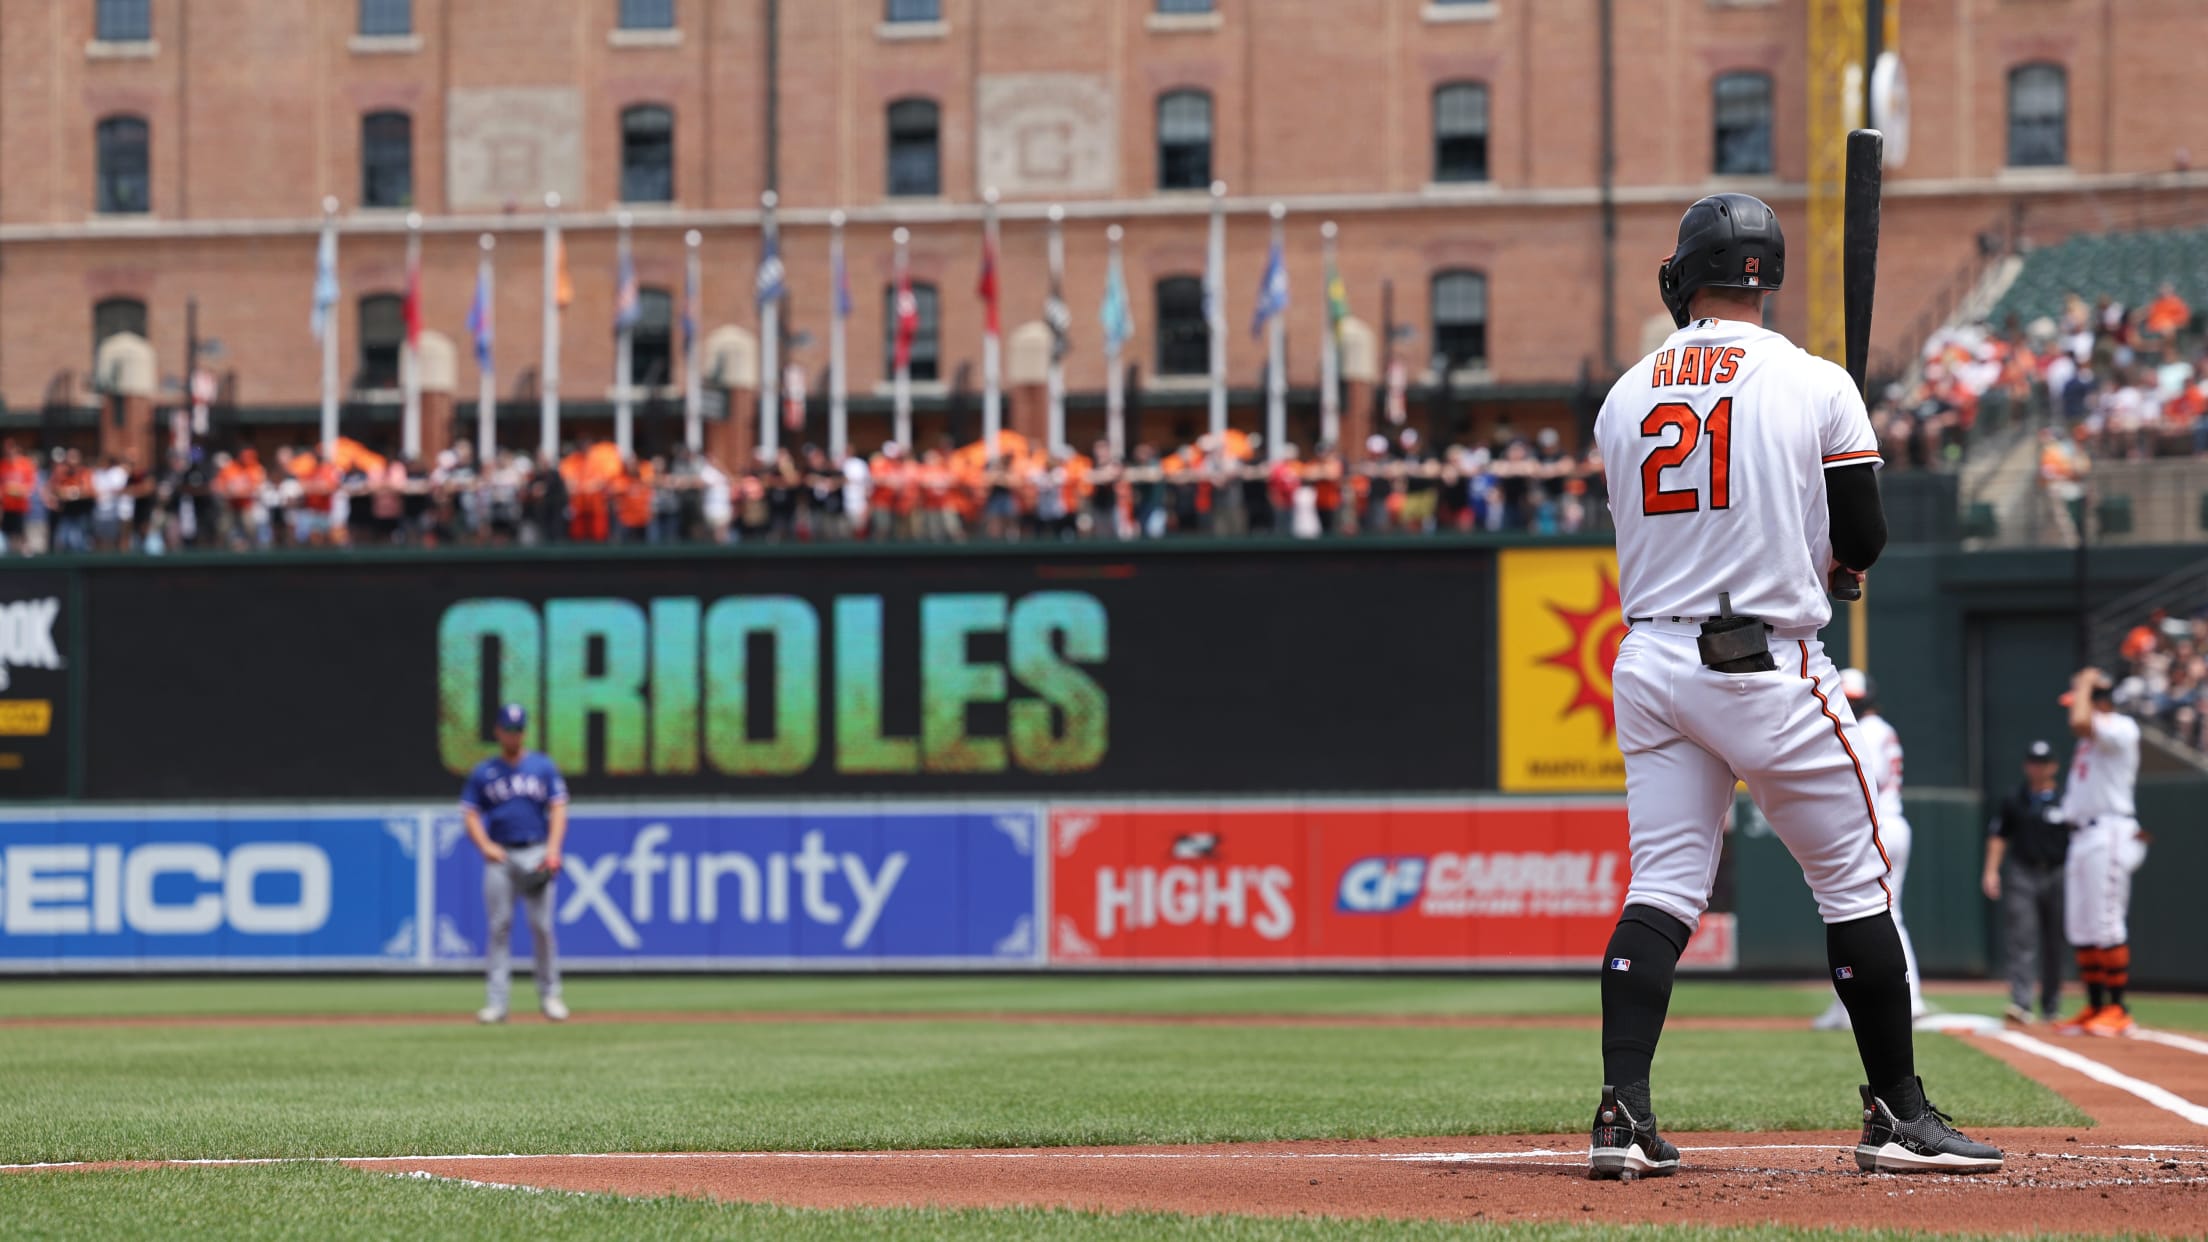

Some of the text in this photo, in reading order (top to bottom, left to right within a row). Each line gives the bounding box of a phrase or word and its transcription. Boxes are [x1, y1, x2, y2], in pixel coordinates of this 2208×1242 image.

[1745, 257, 1760, 273] 21
[1652, 347, 1745, 388] HAYS
[1641, 397, 1733, 516] 21
[438, 591, 1108, 774] ORIOLES
[0, 842, 333, 935] EICO
[559, 824, 907, 948] xfinity
[1097, 866, 1295, 940] HIGH'S
[1426, 852, 1619, 892] CARROLL
